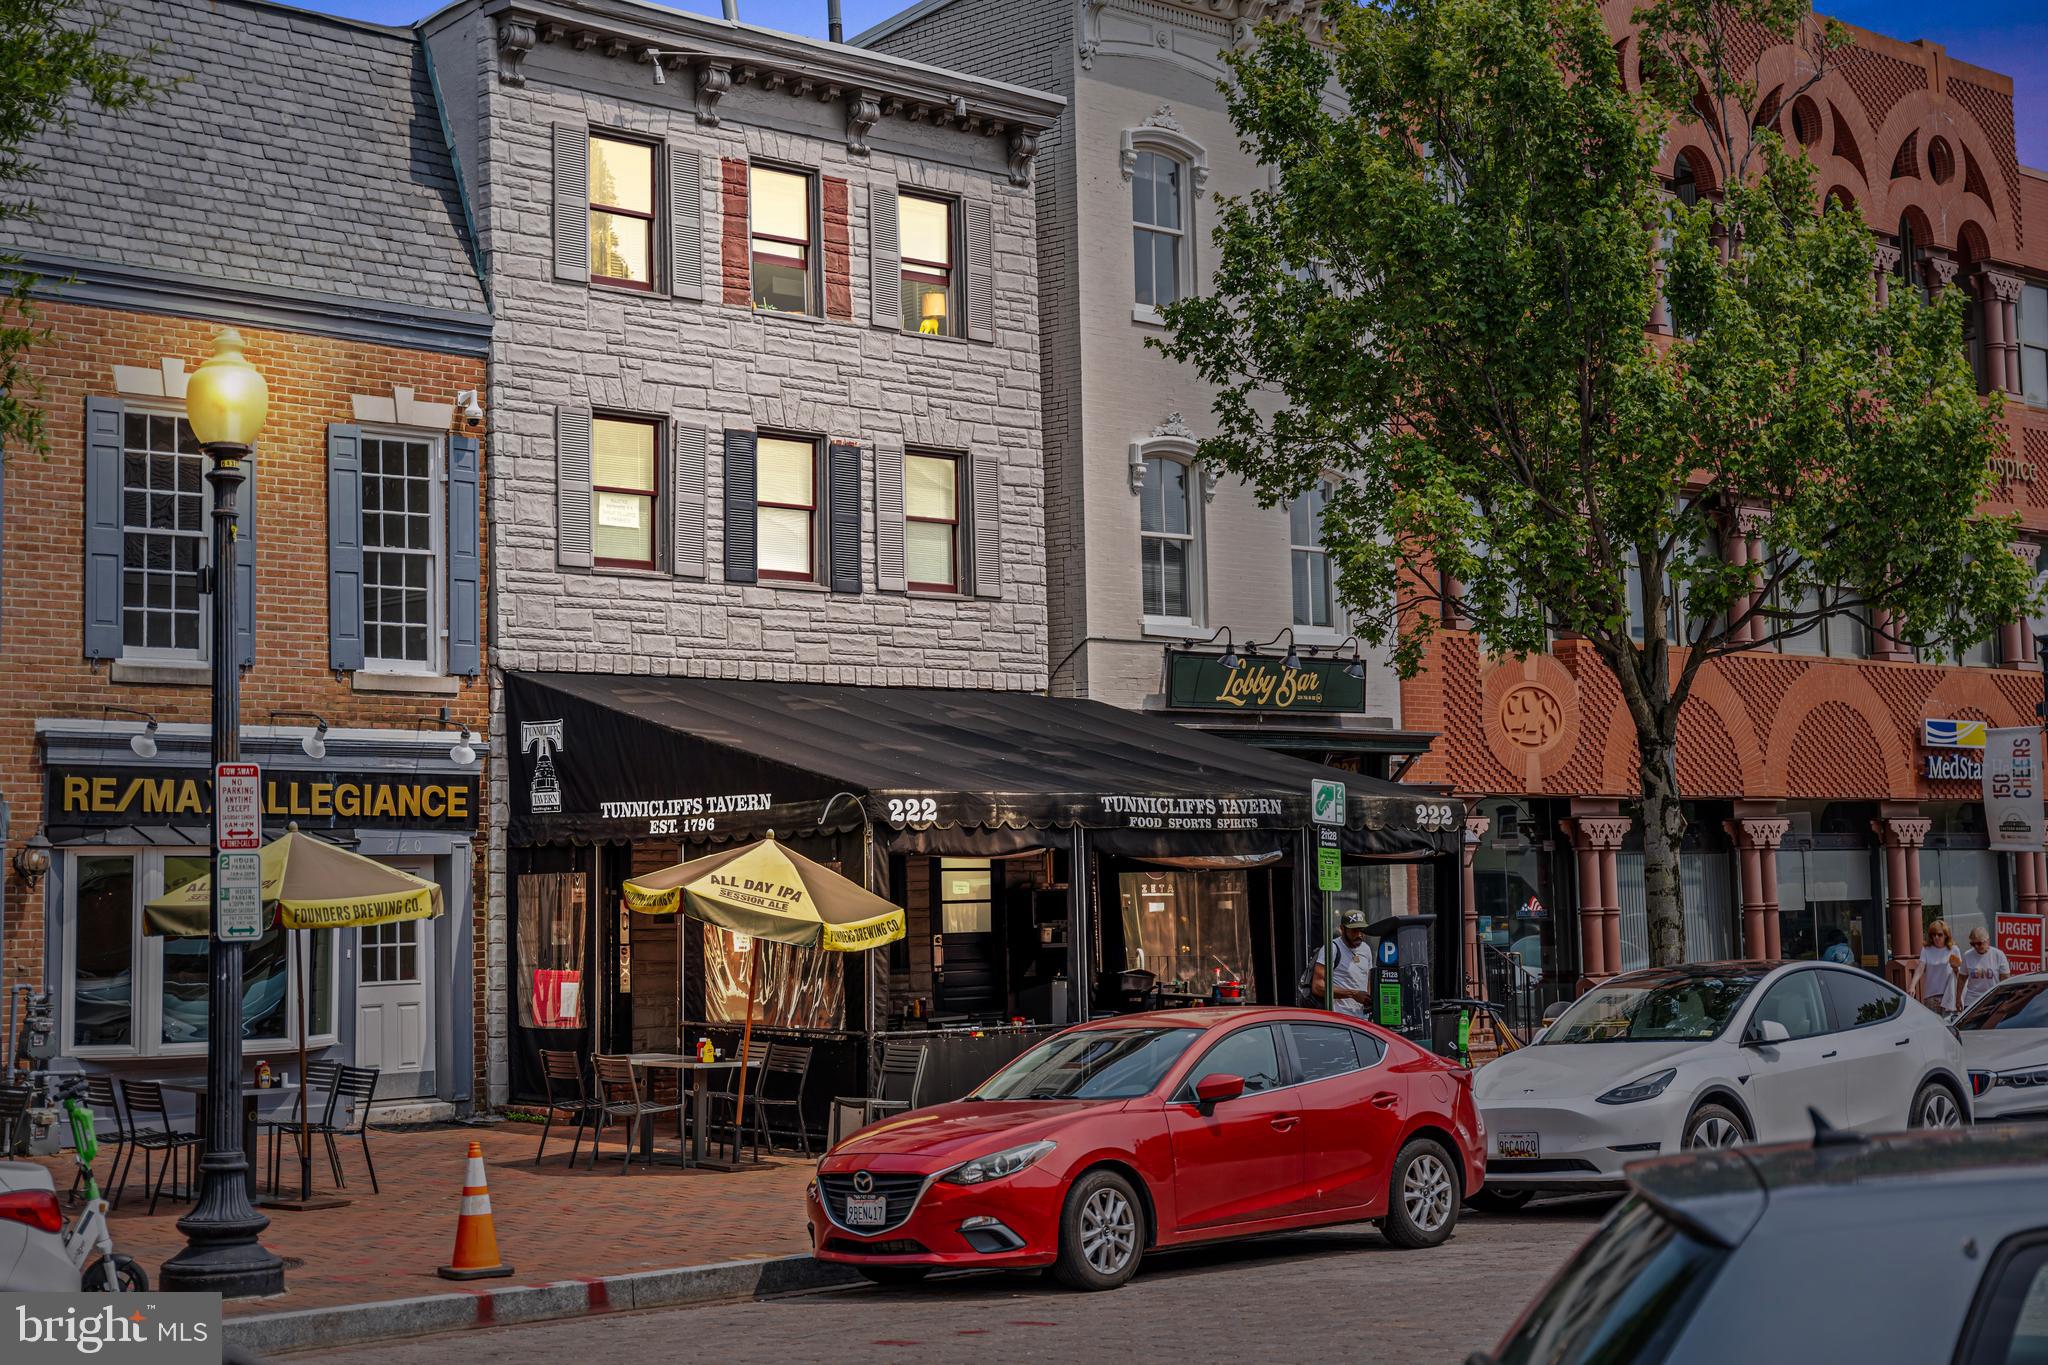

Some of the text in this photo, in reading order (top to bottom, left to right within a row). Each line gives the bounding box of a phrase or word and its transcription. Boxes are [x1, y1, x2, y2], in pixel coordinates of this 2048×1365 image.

[1986, 451, 2037, 488] ospice
[1215, 658, 1319, 707] Lobby Bar
[223, 767, 254, 775] TOW AWAY
[1928, 753, 1983, 780] MedSta
[2013, 738, 2032, 799] CHEERS
[222, 787, 254, 795] PARKING
[1993, 774, 2011, 799] 150
[261, 781, 468, 817] LLEGIANCE
[533, 793, 558, 804] TAVERN
[600, 793, 772, 818] TUNNICLIFFS TAVERN
[1100, 796, 1282, 815] TUNNICLIFFS TAVERN
[888, 798, 938, 822] 222
[1415, 804, 1453, 825] 222
[649, 818, 715, 834] EST. 1796
[1129, 816, 1258, 829] FOOD SPORTS SPIRITS
[221, 857, 229, 868] 2
[185, 882, 210, 893] AL
[710, 874, 803, 903] ALL DAY IPA
[1141, 884, 1175, 893] ZETA
[719, 888, 789, 911] SESSION ALE
[293, 897, 423, 924] FOUNDERS BREWING CO.
[854, 922, 888, 942] BREWING
[1998, 921, 2041, 936] URGENT
[1384, 942, 1396, 963] P
[2005, 938, 2033, 952] CARE
[2009, 962, 2041, 973] NICA DE
[848, 1206, 883, 1221] 9BEN417
